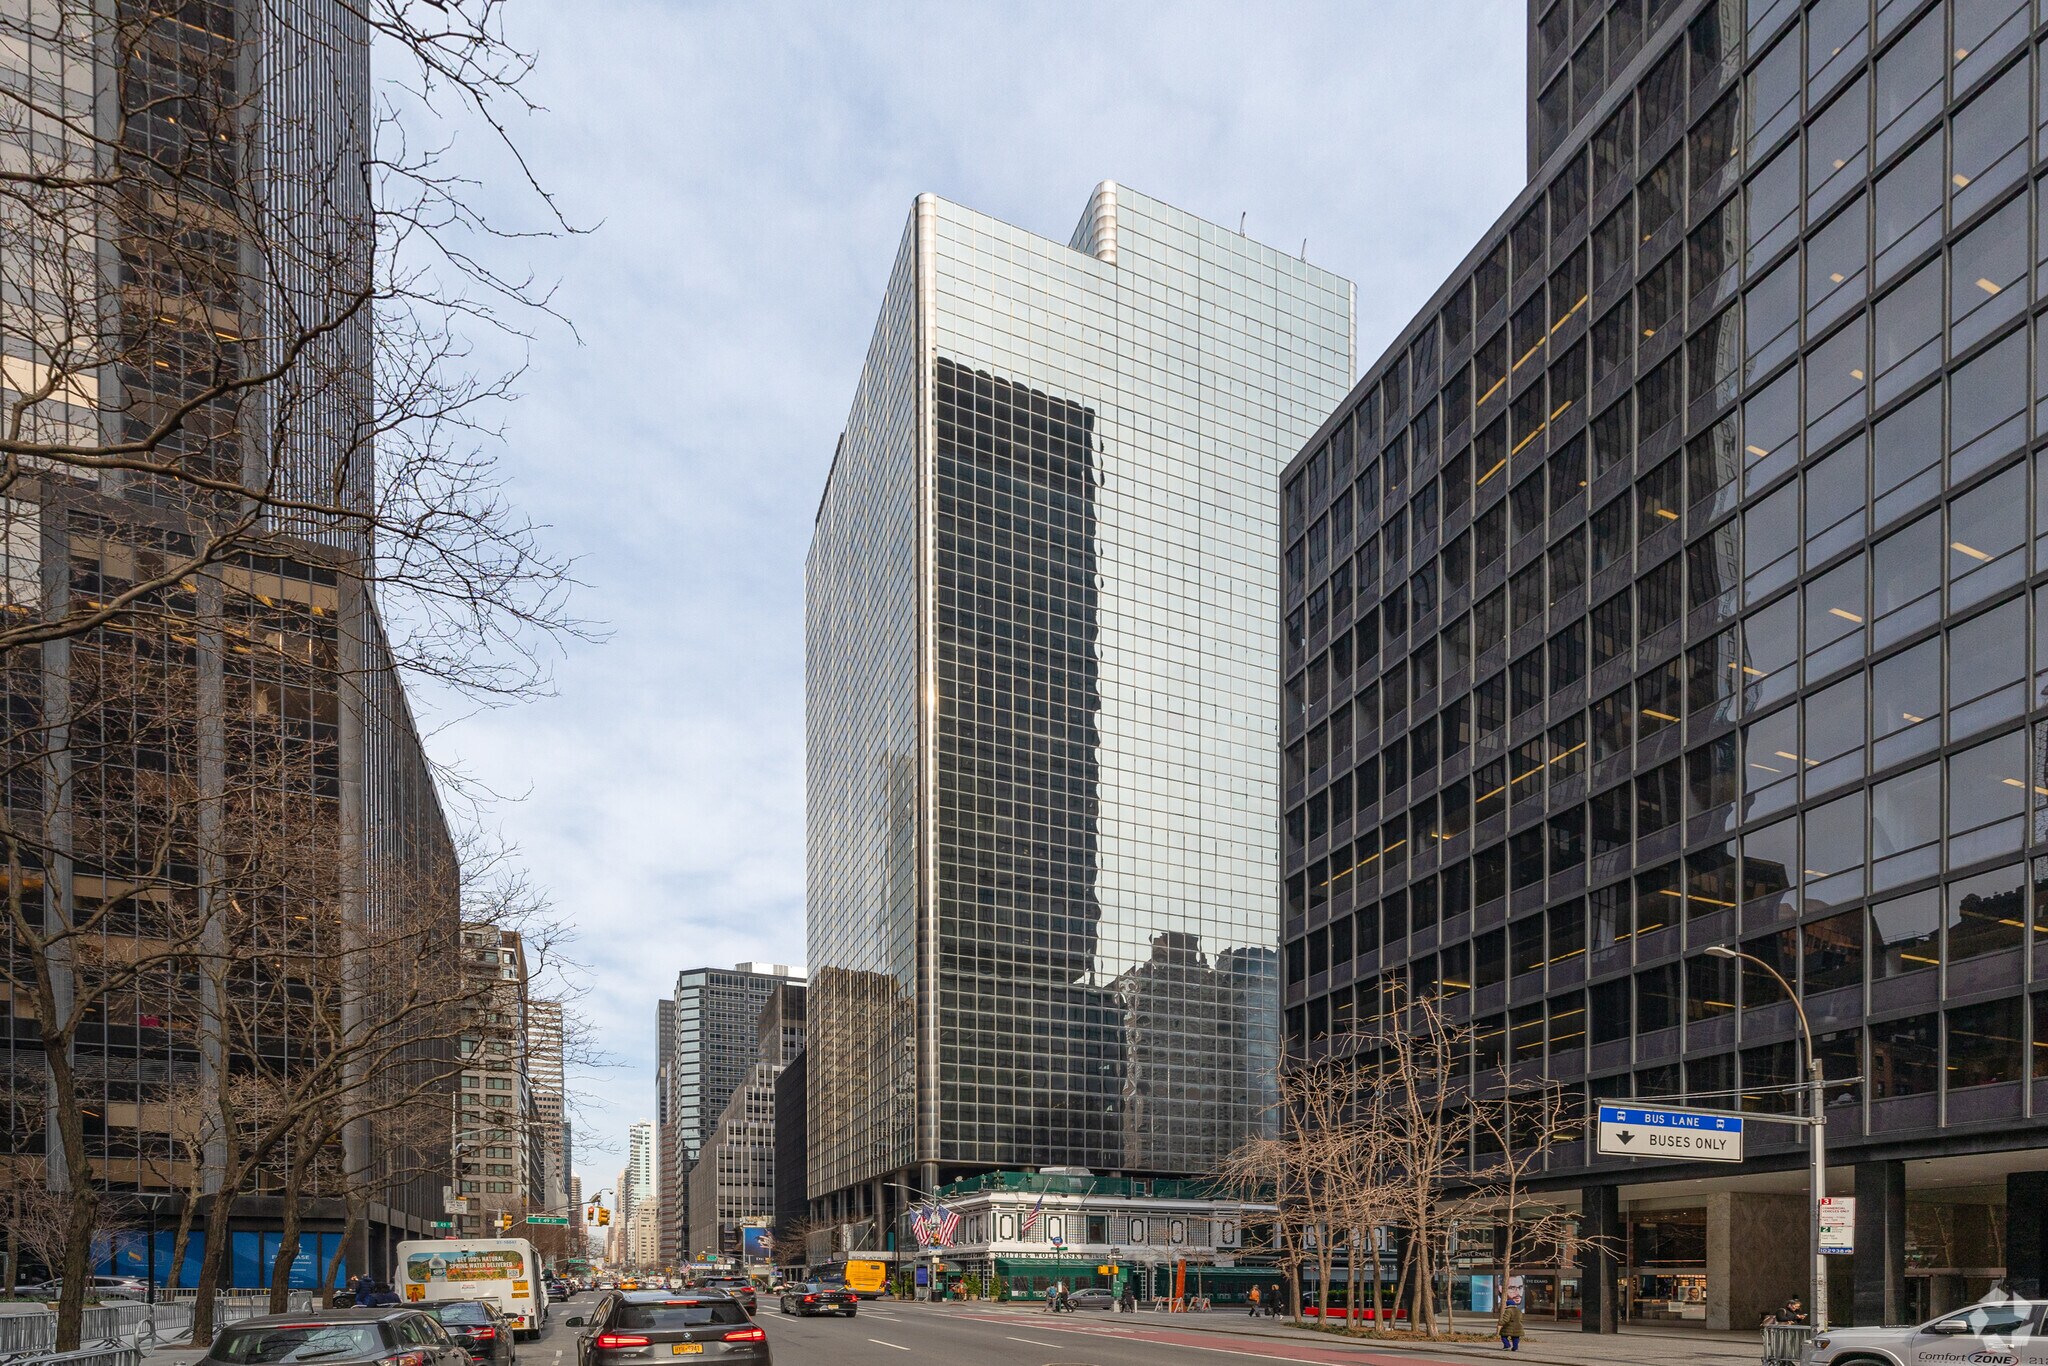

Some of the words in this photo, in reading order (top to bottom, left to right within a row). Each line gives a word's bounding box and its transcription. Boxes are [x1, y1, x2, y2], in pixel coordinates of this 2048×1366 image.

[1645, 1113, 1665, 1124] BUS
[1672, 1116, 1700, 1127] LANE
[1650, 1134, 1691, 1148] BUSES
[1695, 1137, 1727, 1150] ONLY
[1918, 1351, 1967, 1361] Comfort
[1974, 1355, 2012, 1364] ZONE
[2029, 1357, 2048, 1365] 21
